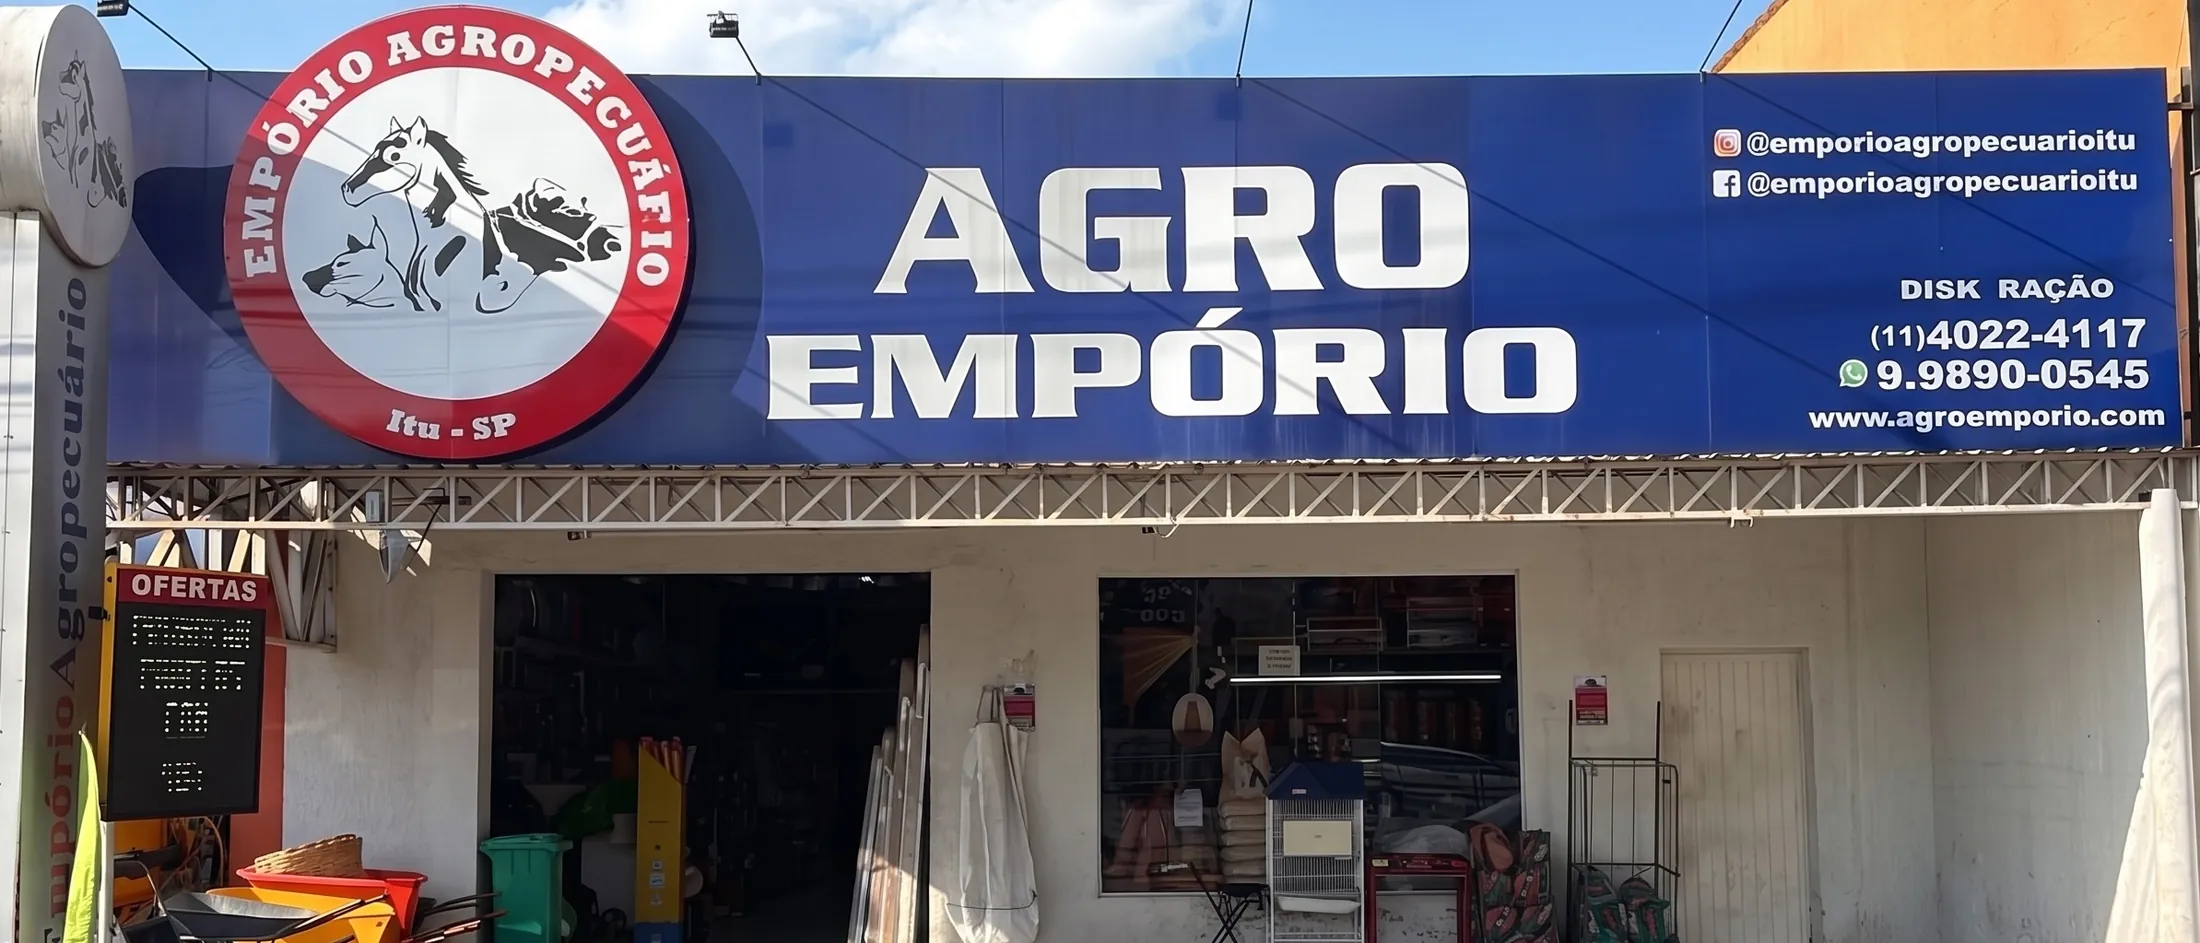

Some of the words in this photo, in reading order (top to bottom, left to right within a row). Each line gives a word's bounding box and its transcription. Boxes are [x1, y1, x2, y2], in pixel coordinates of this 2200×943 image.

[1746, 129, 2136, 158] @emporioagropecuarioitu
[242, 50, 374, 279] EMPÓRIO
[1747, 168, 2138, 199] @emporioagropecuarioitu
[873, 162, 1470, 294] AGRO
[1900, 279, 1982, 300] DISK
[1998, 273, 2114, 304] RAÇÃO
[766, 306, 1578, 421] EMPÓRIO
[1876, 359, 2150, 391] 9.9890-0545
[386, 408, 440, 440] Itu
[472, 412, 516, 441] SP
[1808, 404, 2166, 433] www.agroemporio.com
[131, 573, 257, 602] OFERTAS
